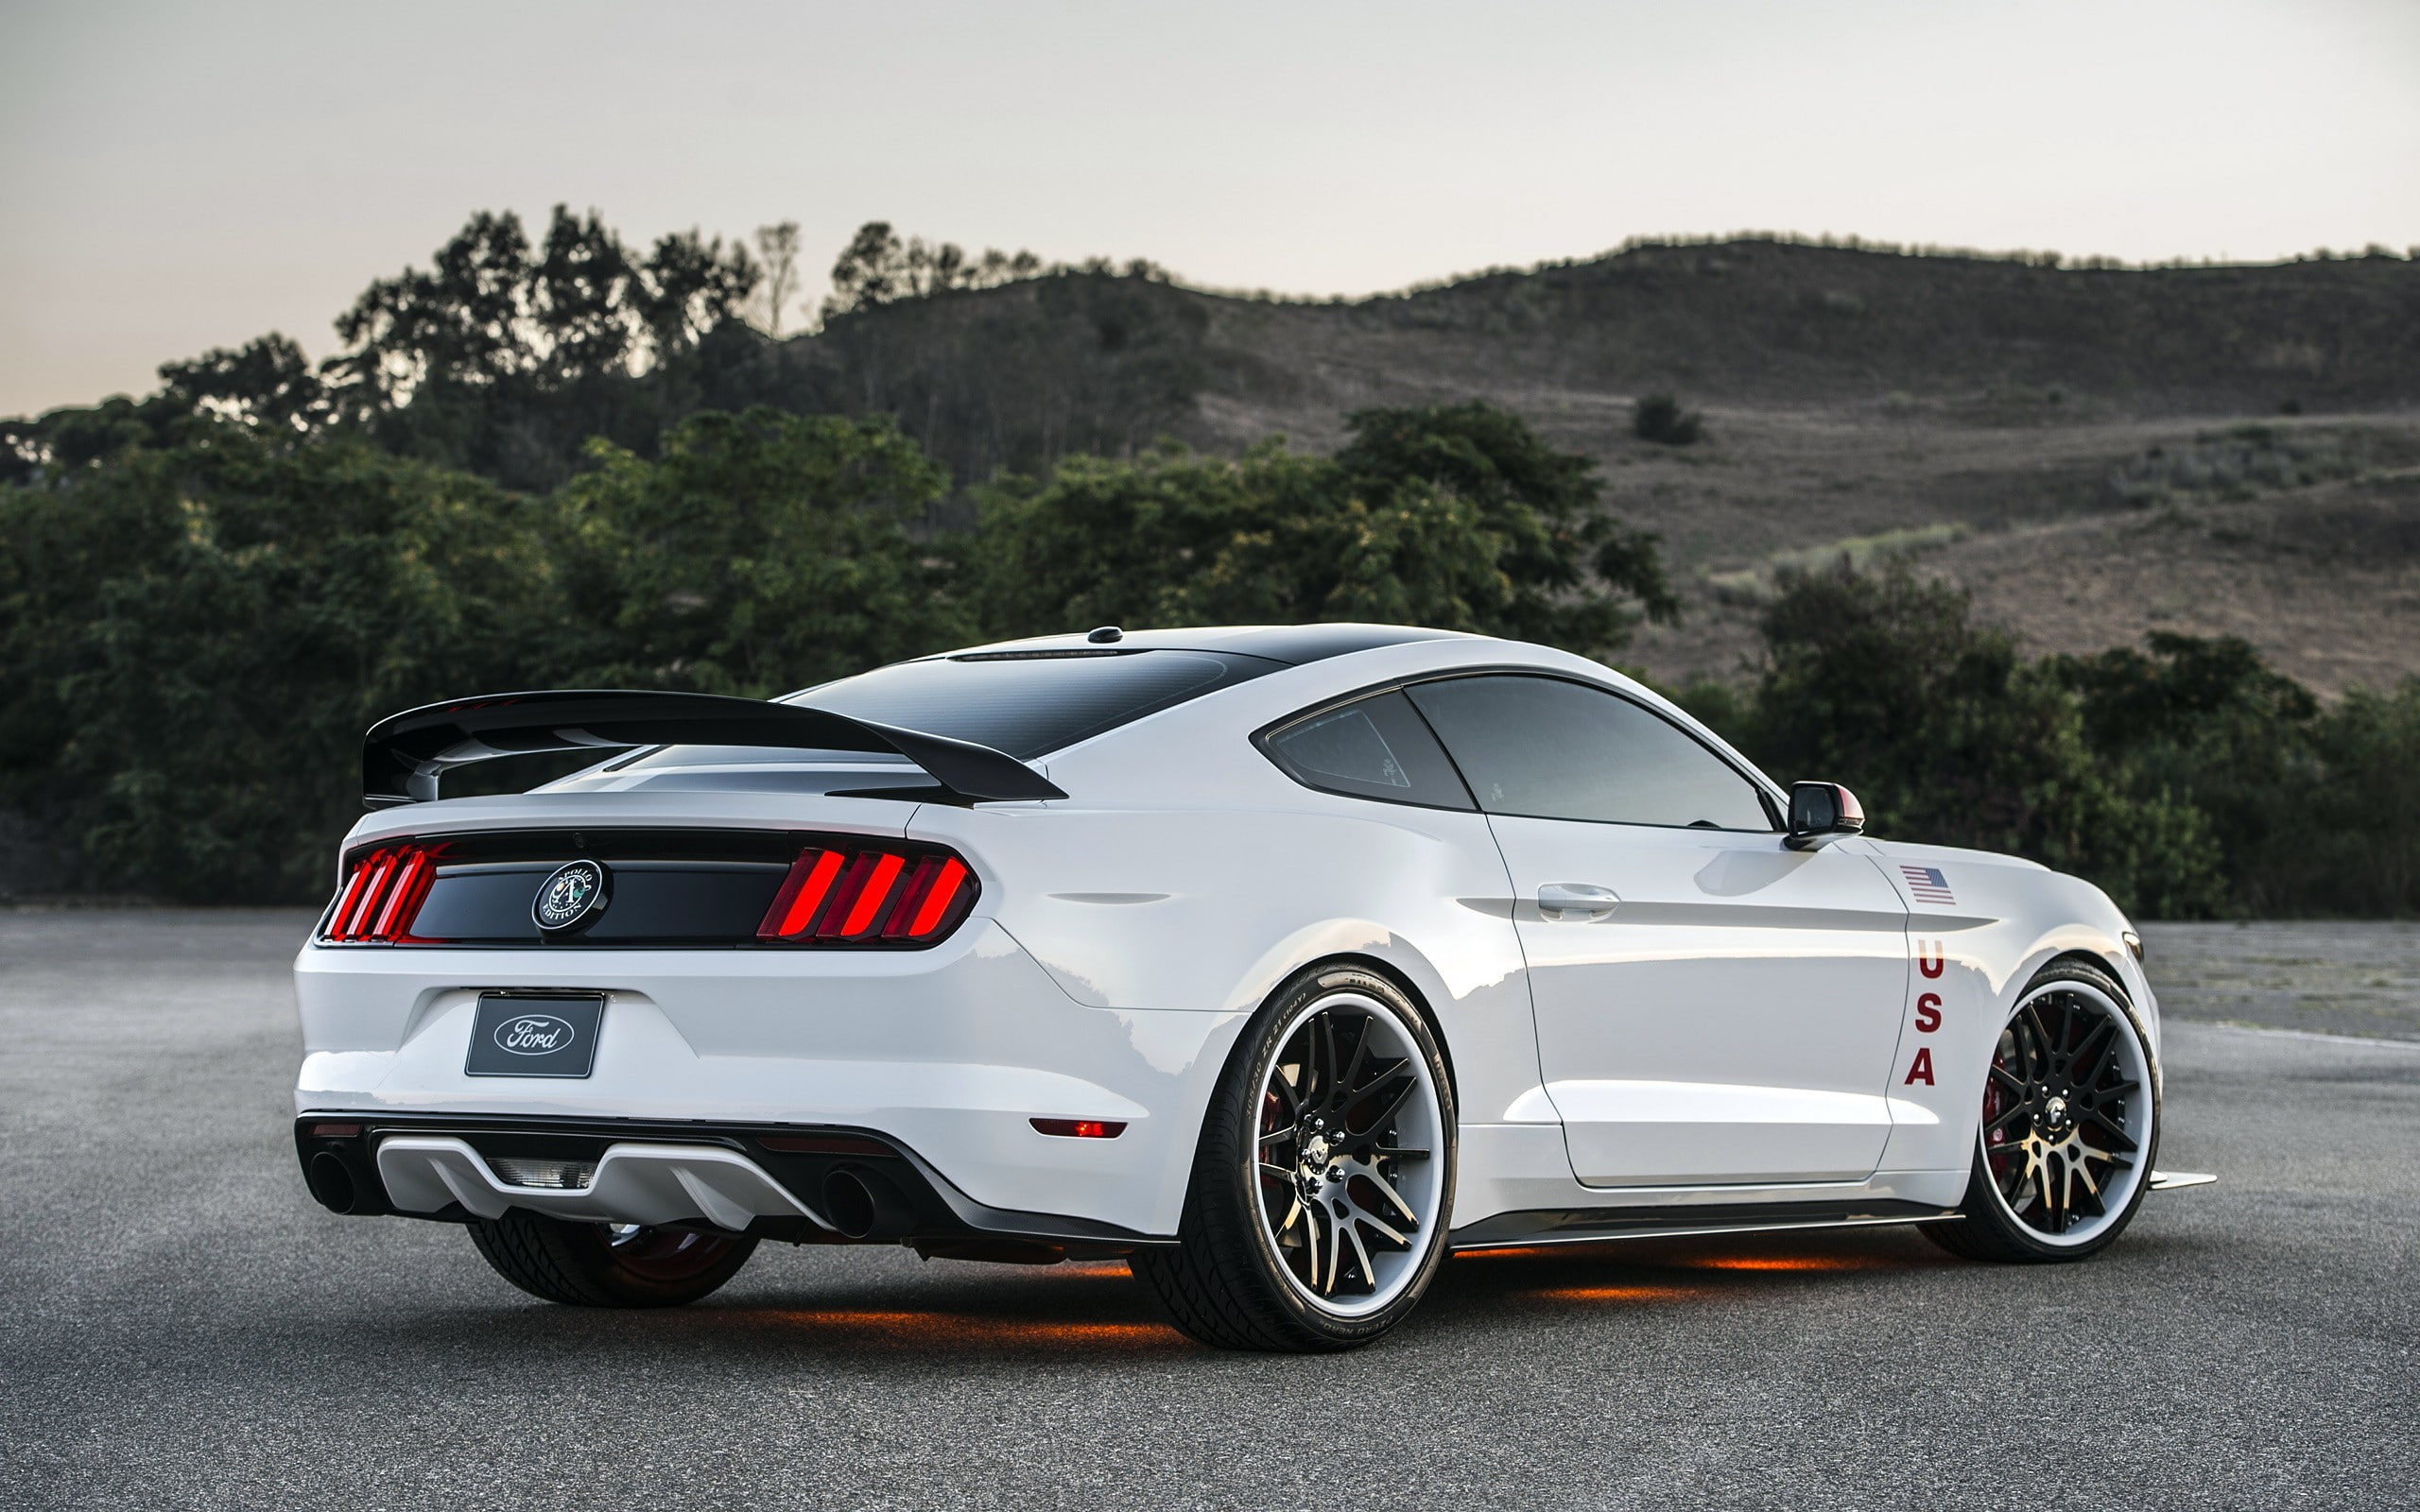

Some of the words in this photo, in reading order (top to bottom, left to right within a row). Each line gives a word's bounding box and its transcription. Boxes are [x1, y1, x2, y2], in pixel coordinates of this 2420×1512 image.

[558, 868, 593, 885] APOLLO
[543, 903, 582, 920] EDITION
[506, 1019, 562, 1049] Ford
[1261, 1035, 1272, 1058] ZR
[1272, 1018, 1282, 1036] 21
